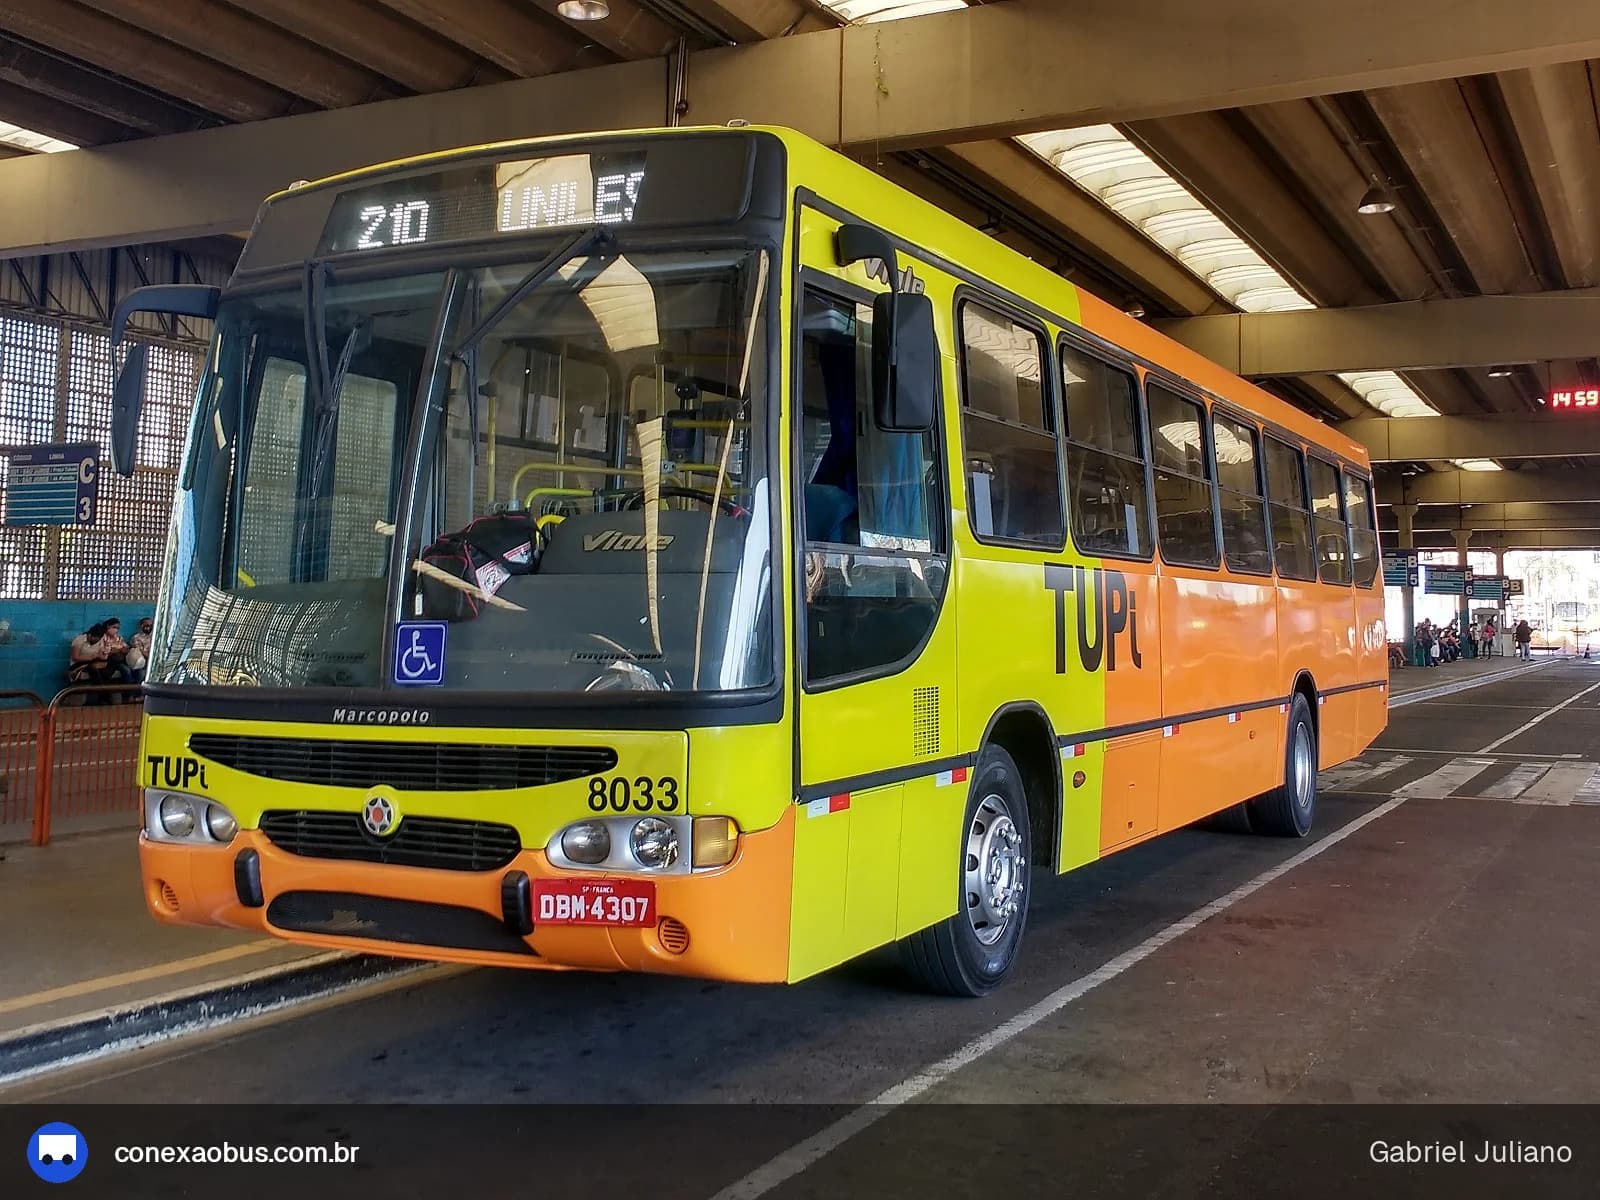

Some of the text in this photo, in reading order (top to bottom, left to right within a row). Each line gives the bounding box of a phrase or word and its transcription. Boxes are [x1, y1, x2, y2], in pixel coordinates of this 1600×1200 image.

[358, 200, 430, 249] 210
[80, 457, 95, 484] C
[79, 496, 92, 521] 3
[1407, 556, 1418, 568] B
[1410, 574, 1418, 586] 5
[1464, 571, 1473, 581] B
[1465, 585, 1473, 594] 6
[1502, 580, 1510, 588] B
[1510, 581, 1521, 591] B
[1503, 592, 1510, 600] 7
[1044, 561, 1142, 674] TUPi
[332, 708, 430, 724] Marcopolo
[148, 755, 209, 790] TUPi
[588, 776, 679, 812] 8033
